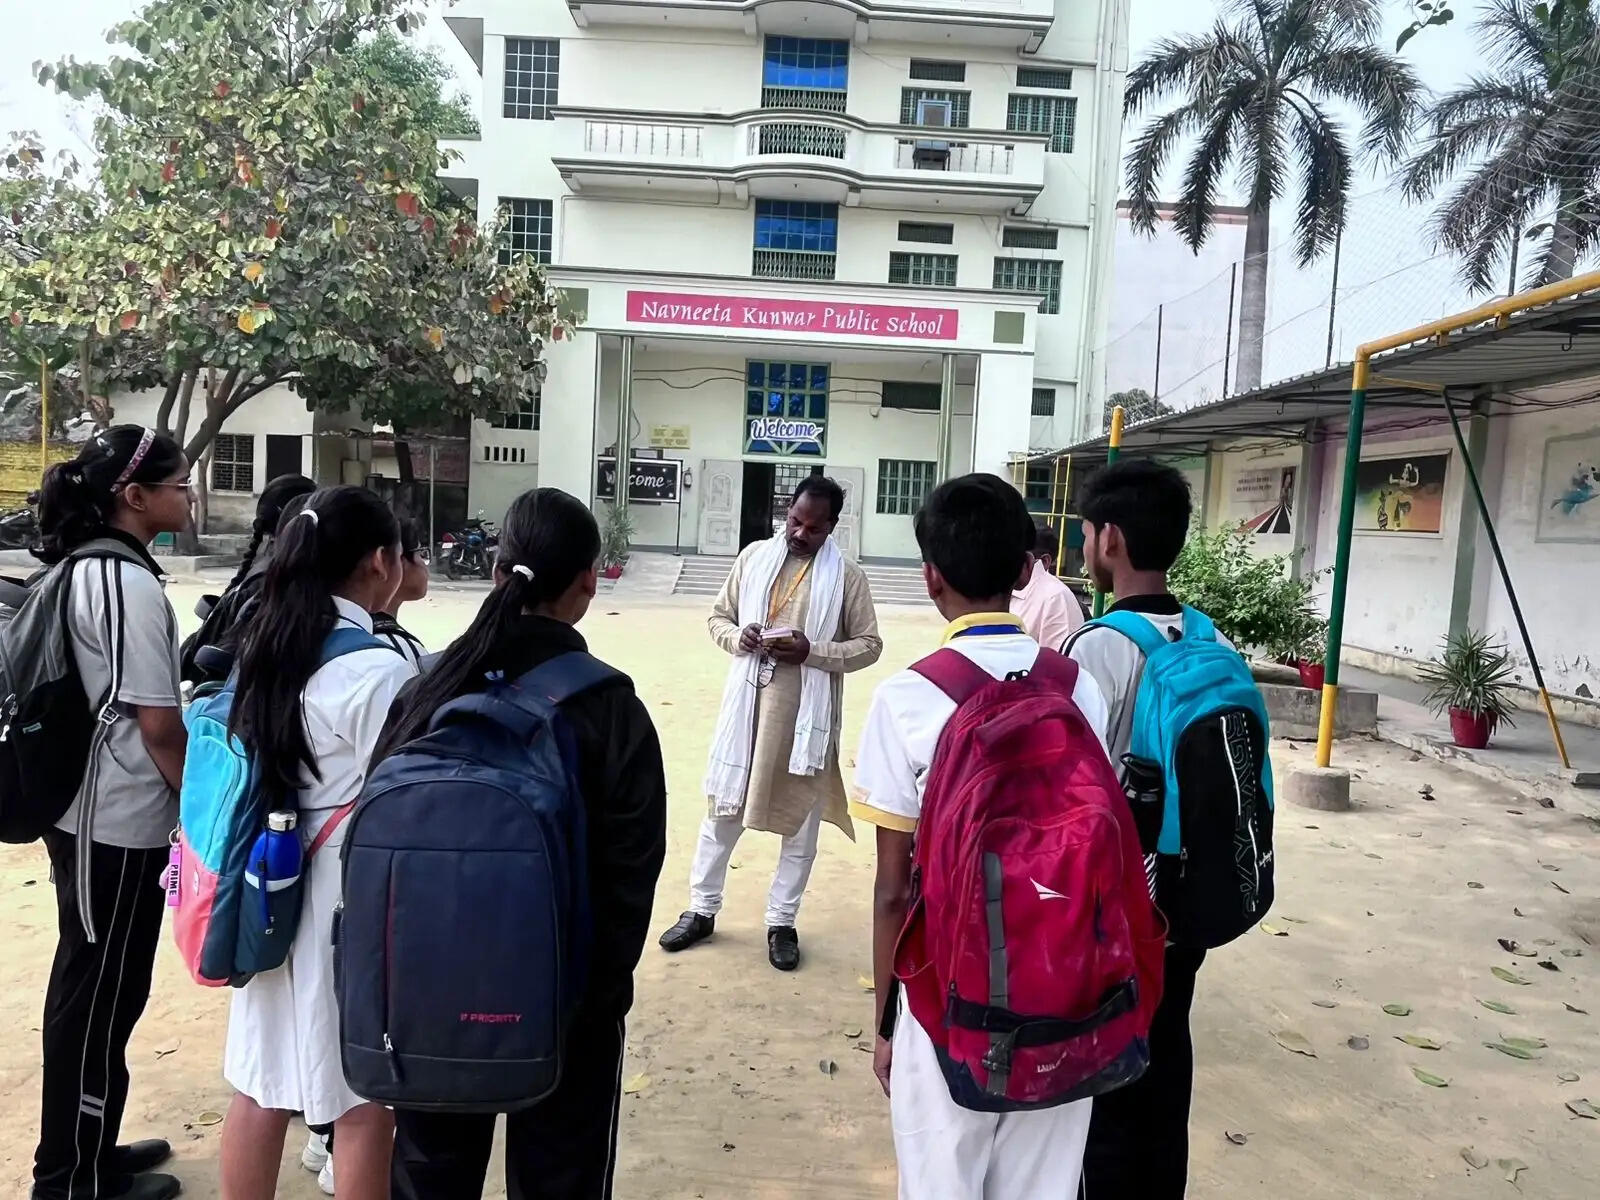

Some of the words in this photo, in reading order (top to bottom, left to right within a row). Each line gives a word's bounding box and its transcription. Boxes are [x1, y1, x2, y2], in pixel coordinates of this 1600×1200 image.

[640, 301, 732, 322] Navneeta
[742, 307, 816, 325] Kunwar
[822, 307, 879, 331] Public
[886, 312, 944, 335] School
[751, 417, 823, 442] Welcome
[605, 470, 664, 488] Wcome
[169, 864, 179, 896] PRIME
